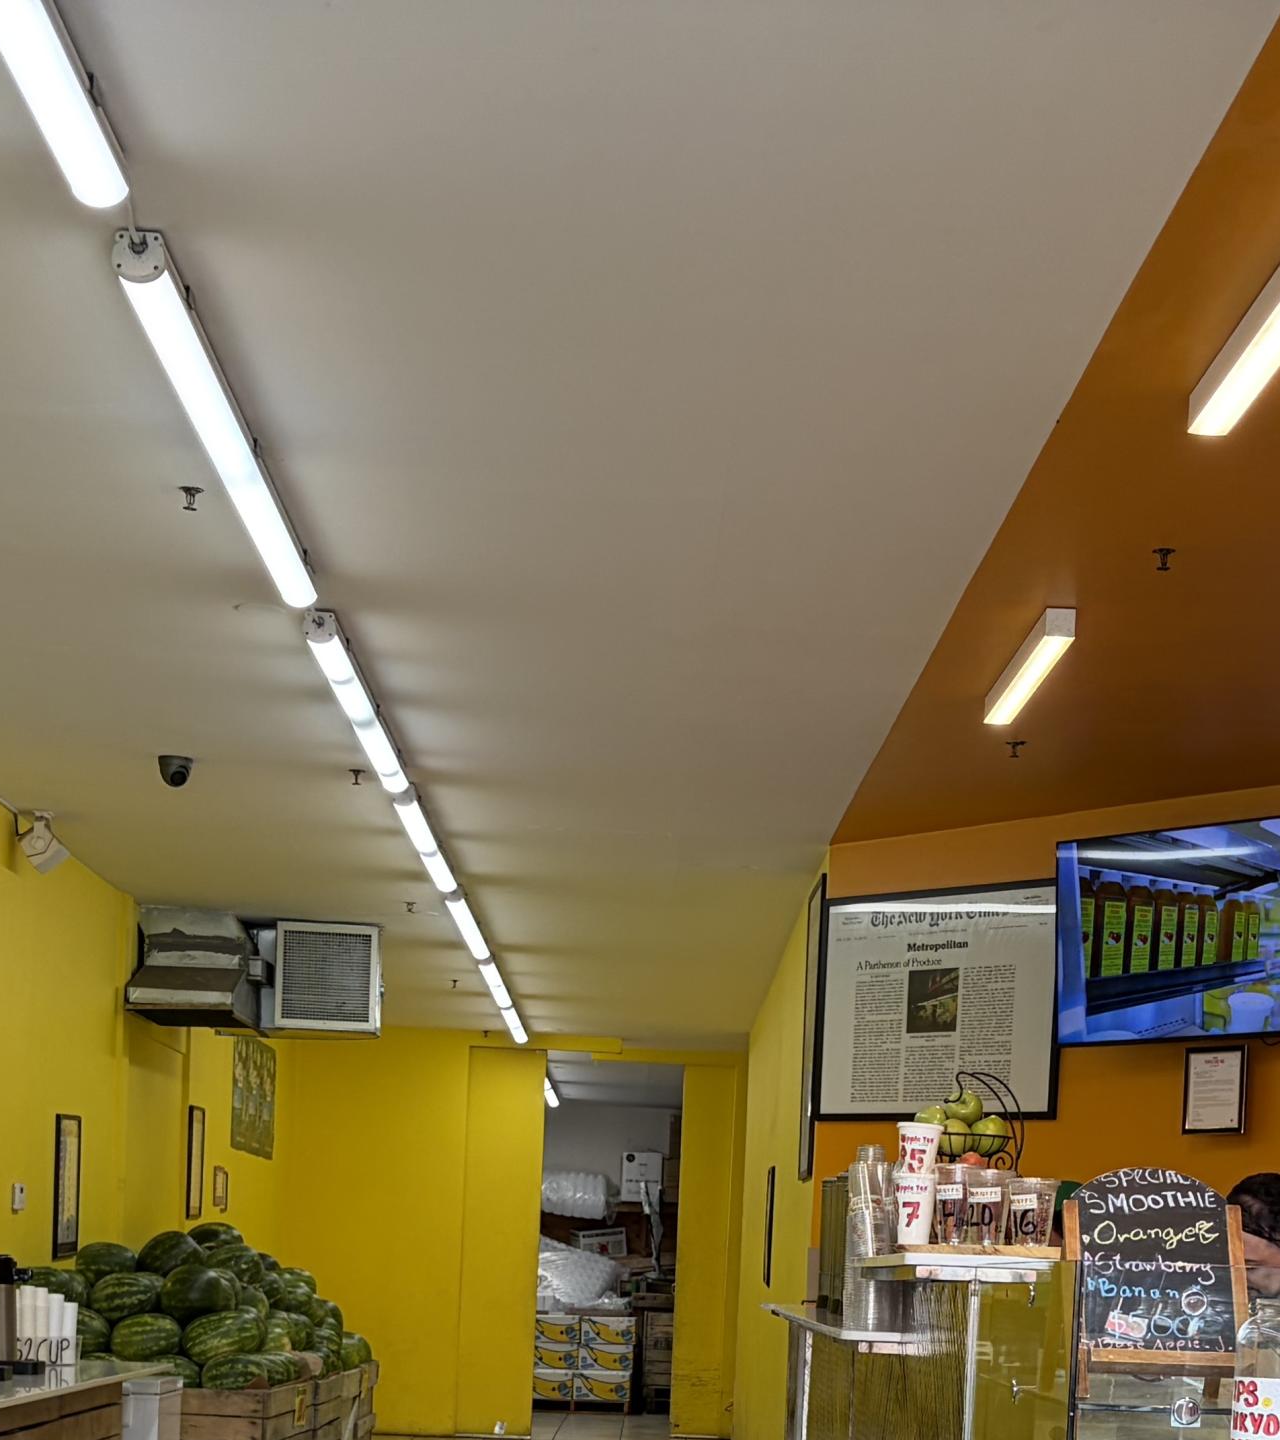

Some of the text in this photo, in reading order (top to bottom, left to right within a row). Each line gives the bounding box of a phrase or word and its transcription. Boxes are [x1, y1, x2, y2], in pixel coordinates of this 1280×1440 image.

[871, 911, 895, 928] The
[897, 911, 925, 926] New
[907, 940, 968, 952] Metropolitan
[856, 957, 942, 971] A Parthenon of Produce
[1085, 1192, 1217, 1214] SMOOTHIE
[902, 1202, 920, 1227] 7
[1013, 1209, 1036, 1238] 16
[1095, 1251, 1216, 1285] Strawberry
